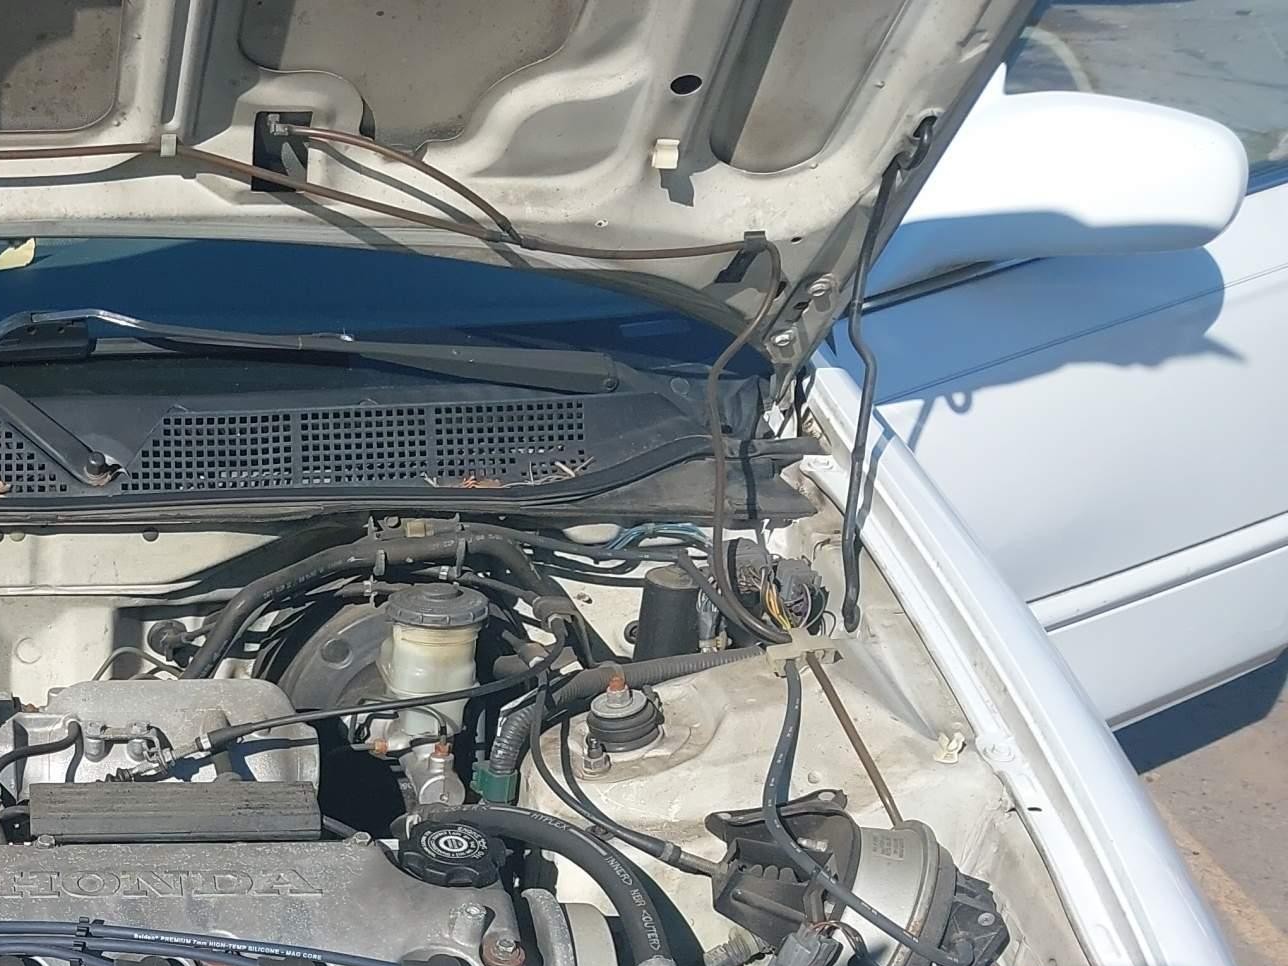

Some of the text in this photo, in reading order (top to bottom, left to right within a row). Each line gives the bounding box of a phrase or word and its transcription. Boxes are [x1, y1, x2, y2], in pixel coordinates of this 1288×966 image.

[530, 812, 571, 831] HYPLEX
[471, 850, 485, 860] OIL
[630, 888, 646, 907] NBR
[160, 936, 192, 945] PREMIUM
[208, 940, 247, 950] HIGH-TEMP
[247, 946, 280, 955] SILICONE
[285, 950, 301, 958] MAG
[302, 952, 323, 960] CORE
